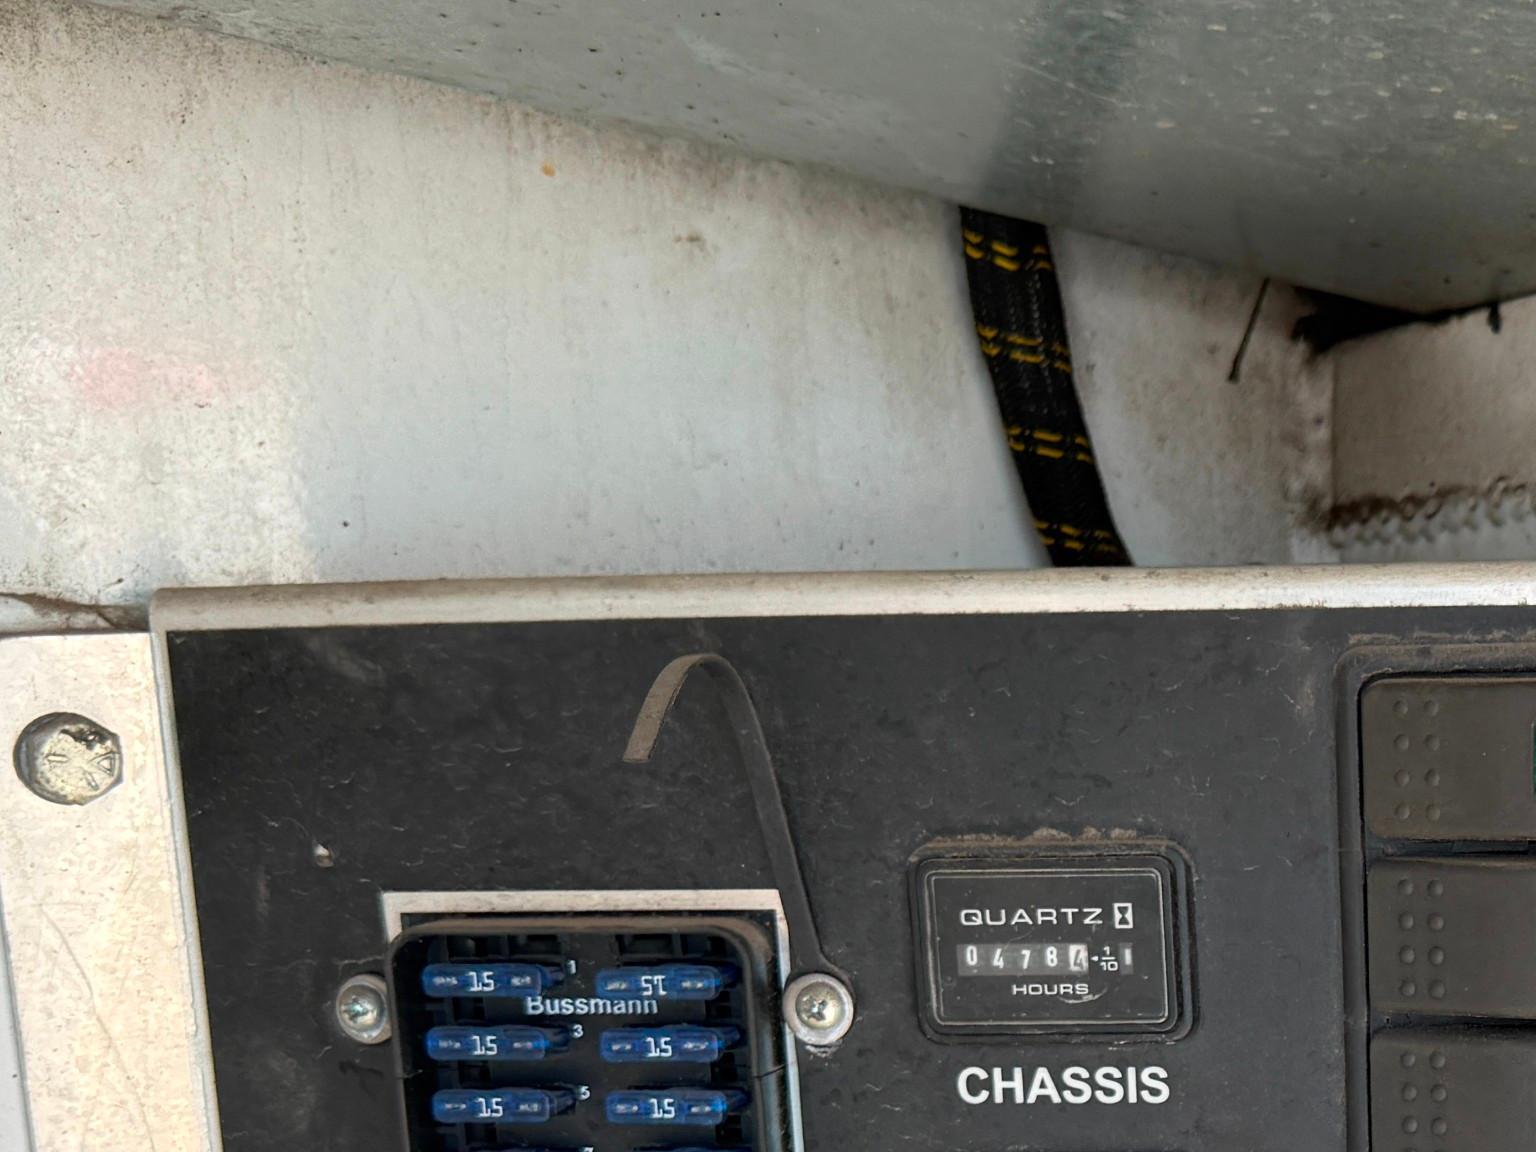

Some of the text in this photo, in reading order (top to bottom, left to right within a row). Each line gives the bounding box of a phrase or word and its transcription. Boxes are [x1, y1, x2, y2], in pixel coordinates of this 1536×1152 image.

[960, 907, 1103, 926] QUARTZ
[567, 959, 577, 974] 1
[467, 971, 495, 992] 15
[1012, 983, 1089, 996] HOURS
[526, 996, 658, 1015] Bussmann
[572, 1023, 584, 1039] 3
[471, 1035, 498, 1056] 15
[645, 1036, 673, 1058] 15
[579, 1085, 591, 1100] 5
[957, 1066, 1170, 1105] CHASSIS
[475, 1097, 504, 1118] 15
[648, 1098, 676, 1119] 15
